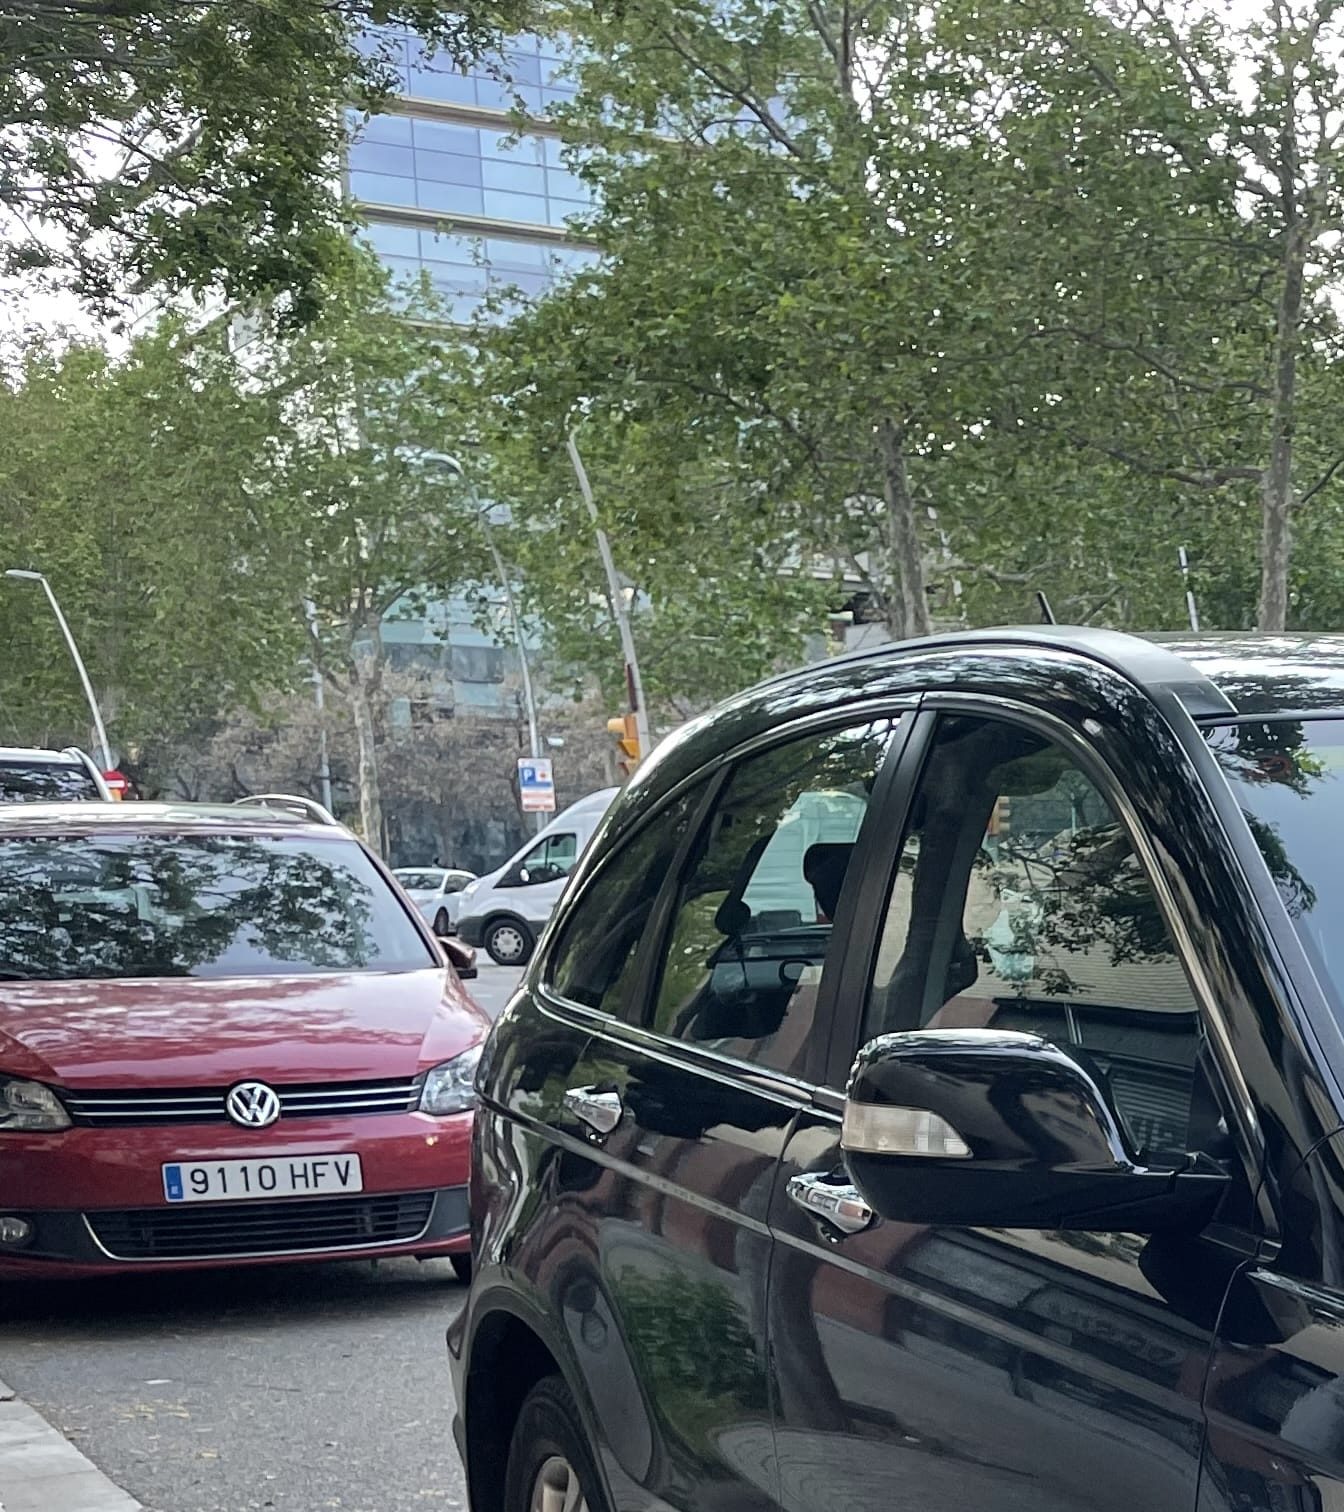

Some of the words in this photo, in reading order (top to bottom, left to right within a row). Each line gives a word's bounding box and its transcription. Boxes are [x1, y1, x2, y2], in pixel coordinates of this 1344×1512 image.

[523, 768, 533, 782] P
[189, 1164, 277, 1195] 9110
[289, 1160, 351, 1190] HFV
